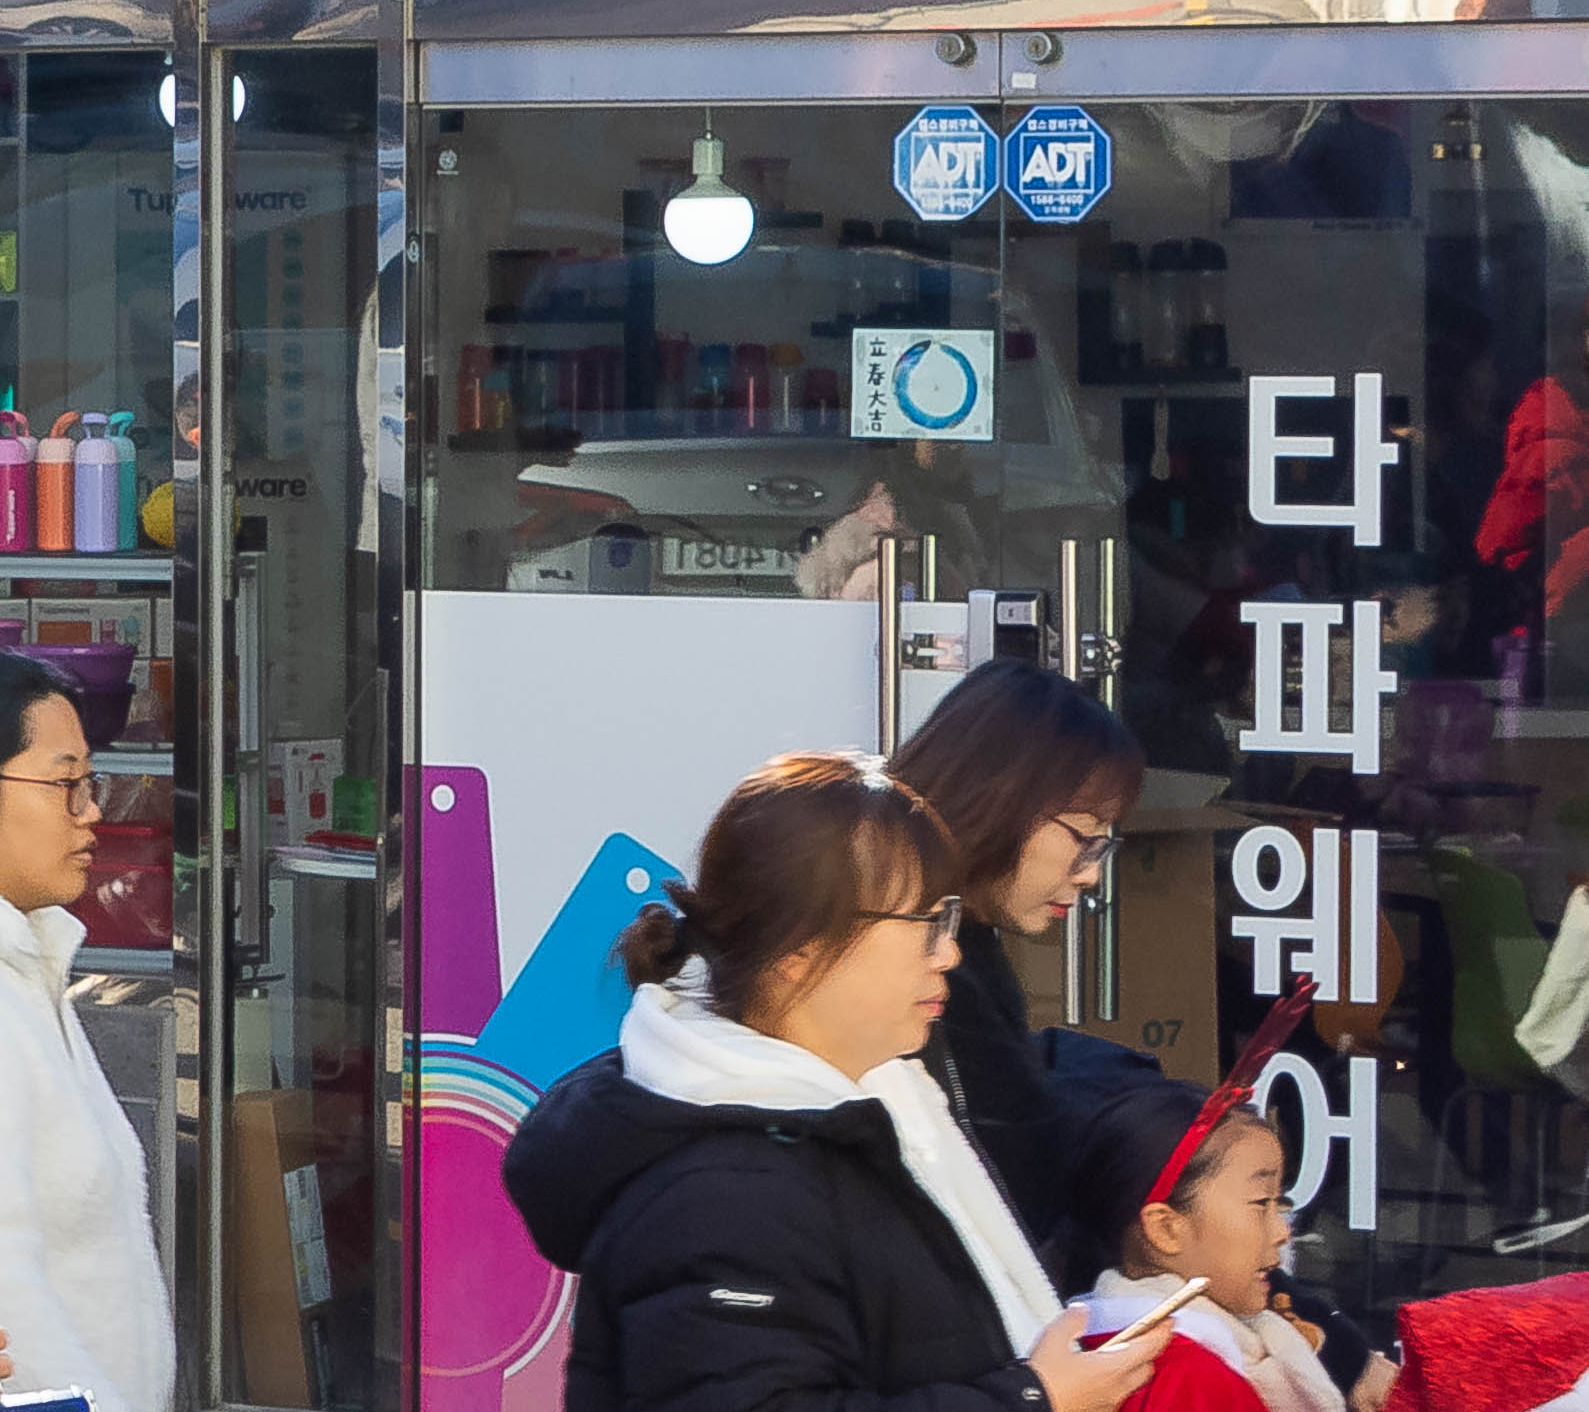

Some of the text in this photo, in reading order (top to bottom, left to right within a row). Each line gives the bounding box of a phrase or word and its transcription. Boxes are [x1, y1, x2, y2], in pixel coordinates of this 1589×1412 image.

[913, 141, 984, 187] ADT
[1022, 141, 1094, 187] ADT
[867, 336, 888, 433] 立春大吉
[1232, 372, 1399, 1231] 타파웨어
[1141, 1019, 1183, 1049] 07
